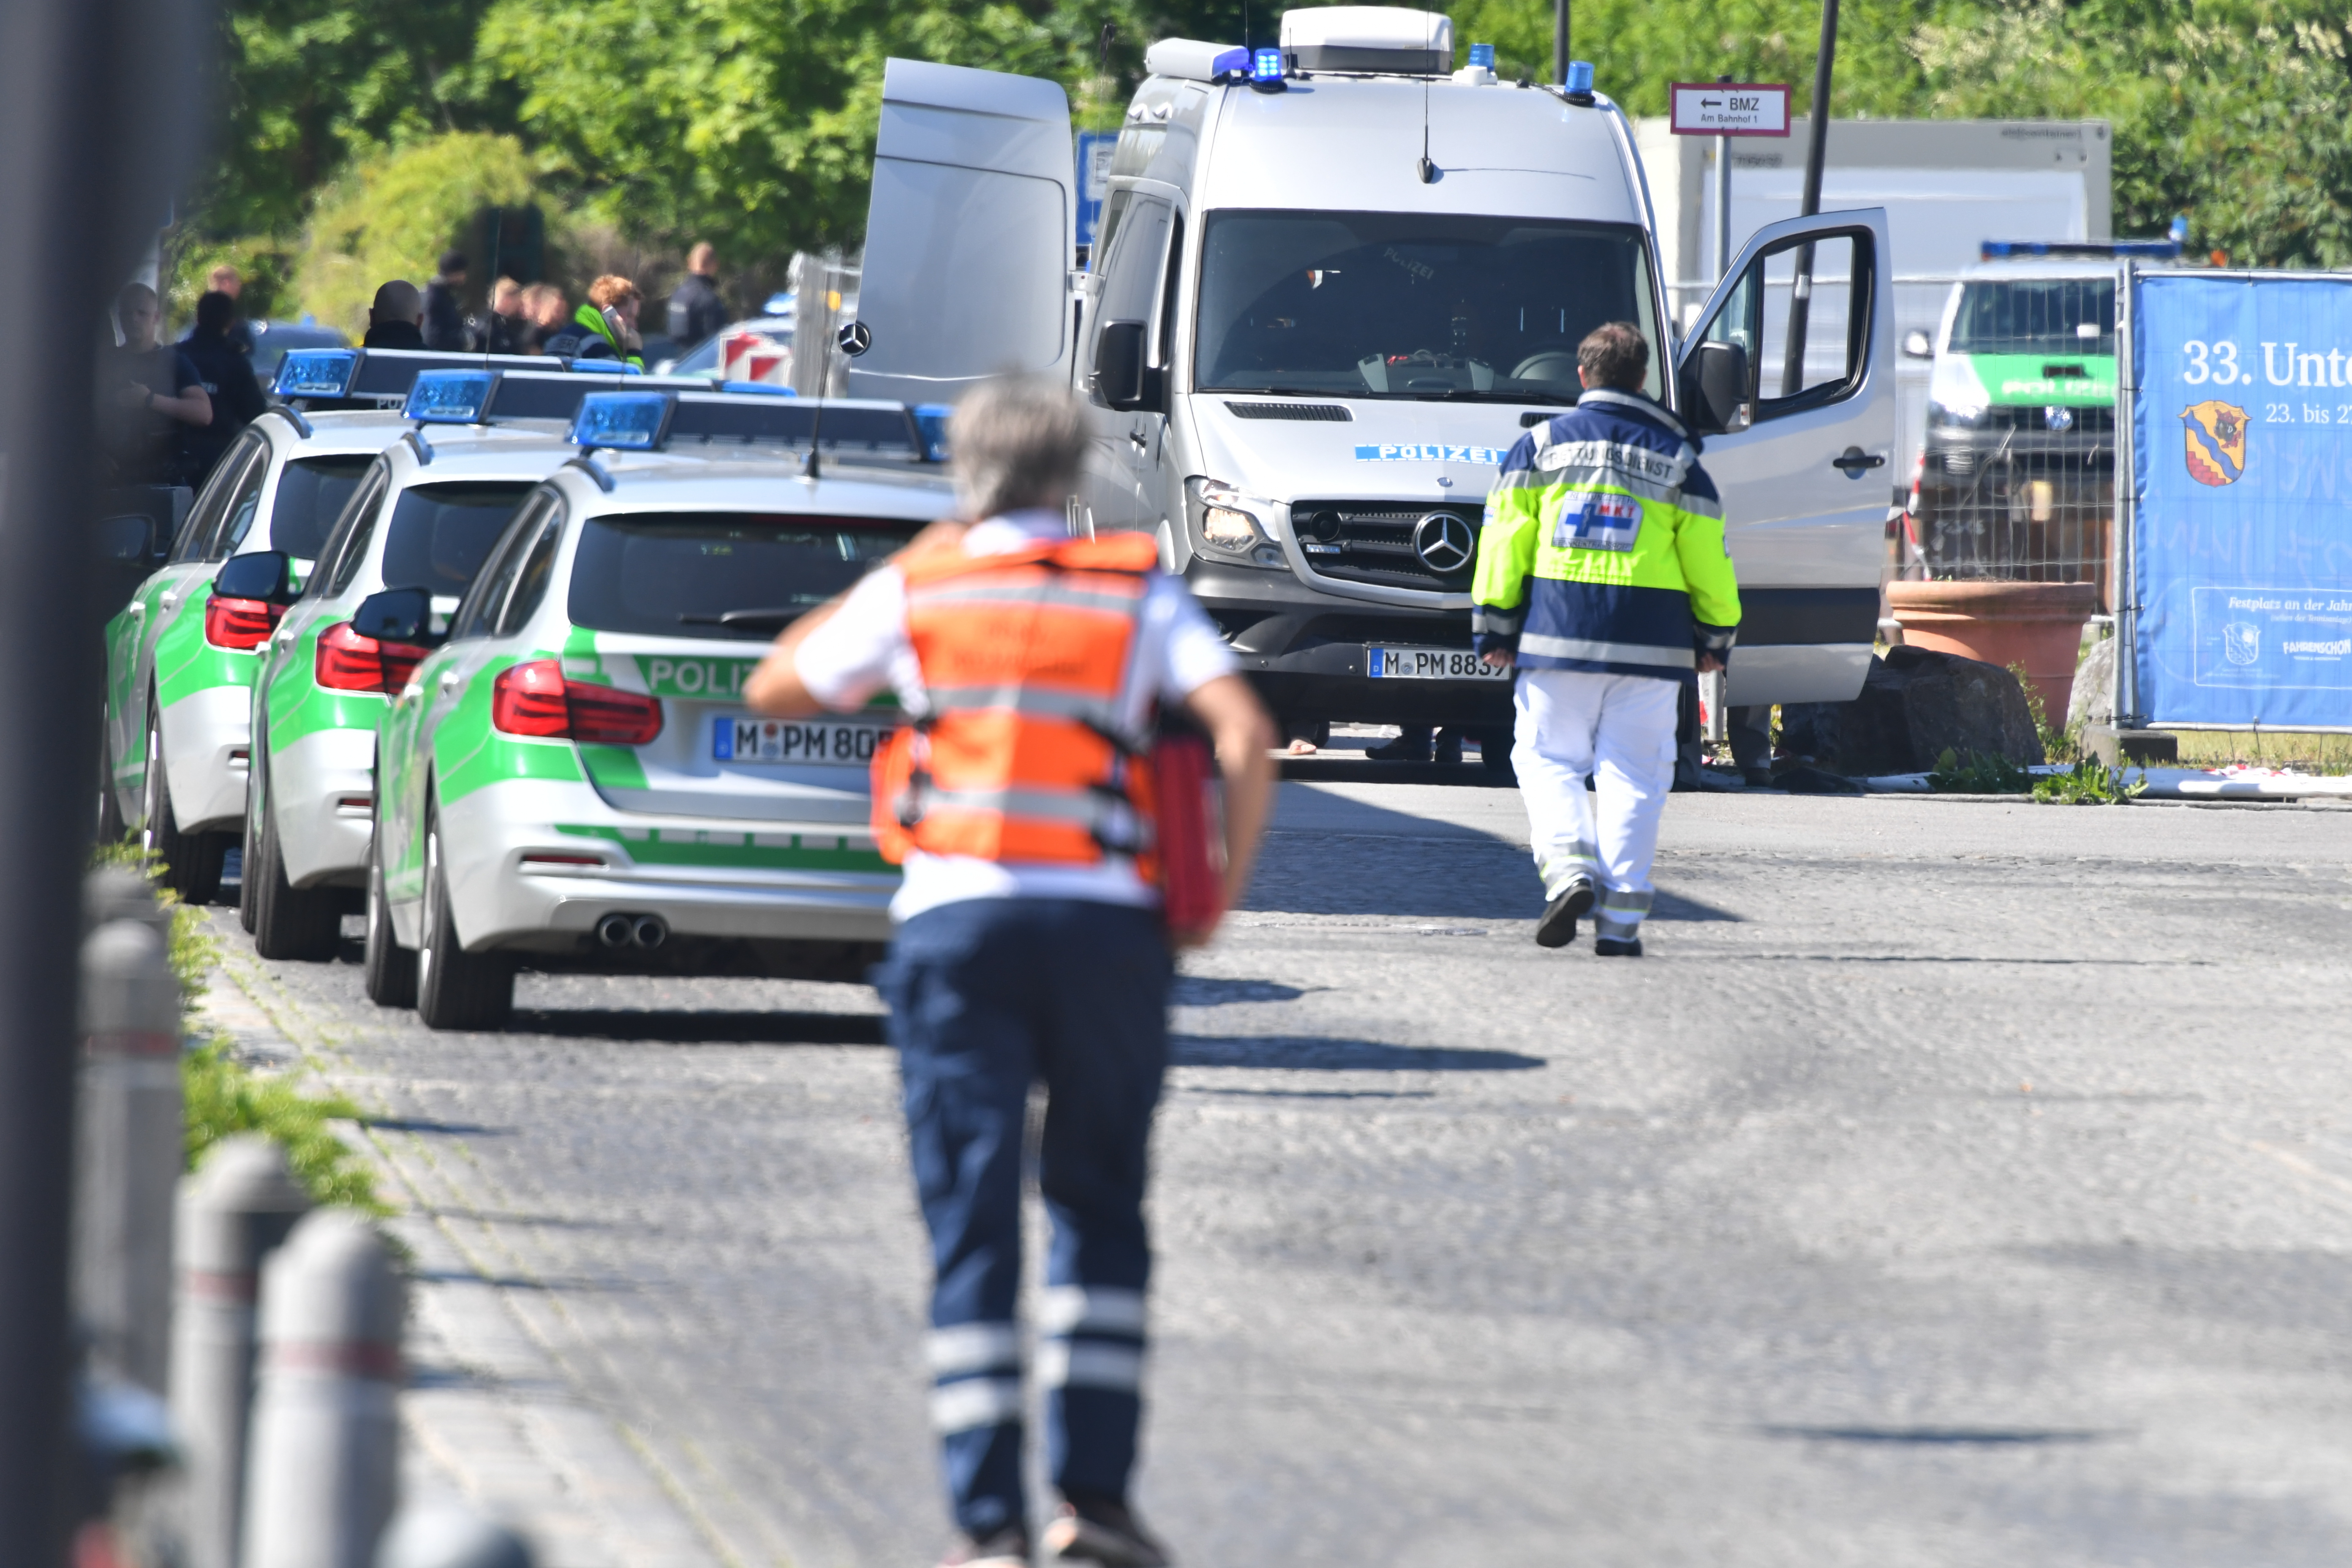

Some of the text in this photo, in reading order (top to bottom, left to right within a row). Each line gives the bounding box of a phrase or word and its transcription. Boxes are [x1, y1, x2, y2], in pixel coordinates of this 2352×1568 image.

[1729, 98, 1760, 111] BMZ
[1701, 114, 1758, 123] Am Bahnhof 1
[2183, 340, 2252, 386] 33.
[2266, 403, 2295, 423] 23.
[2302, 403, 2329, 423] bis
[1379, 446, 1498, 463] POLIZEI
[2228, 597, 2281, 612] Festplatz
[2284, 599, 2300, 610] an
[2304, 598, 2325, 611] der
[1384, 652, 1399, 675] M
[1415, 652, 1445, 675] PM
[737, 724, 757, 754] M
[784, 725, 826, 757] PM
